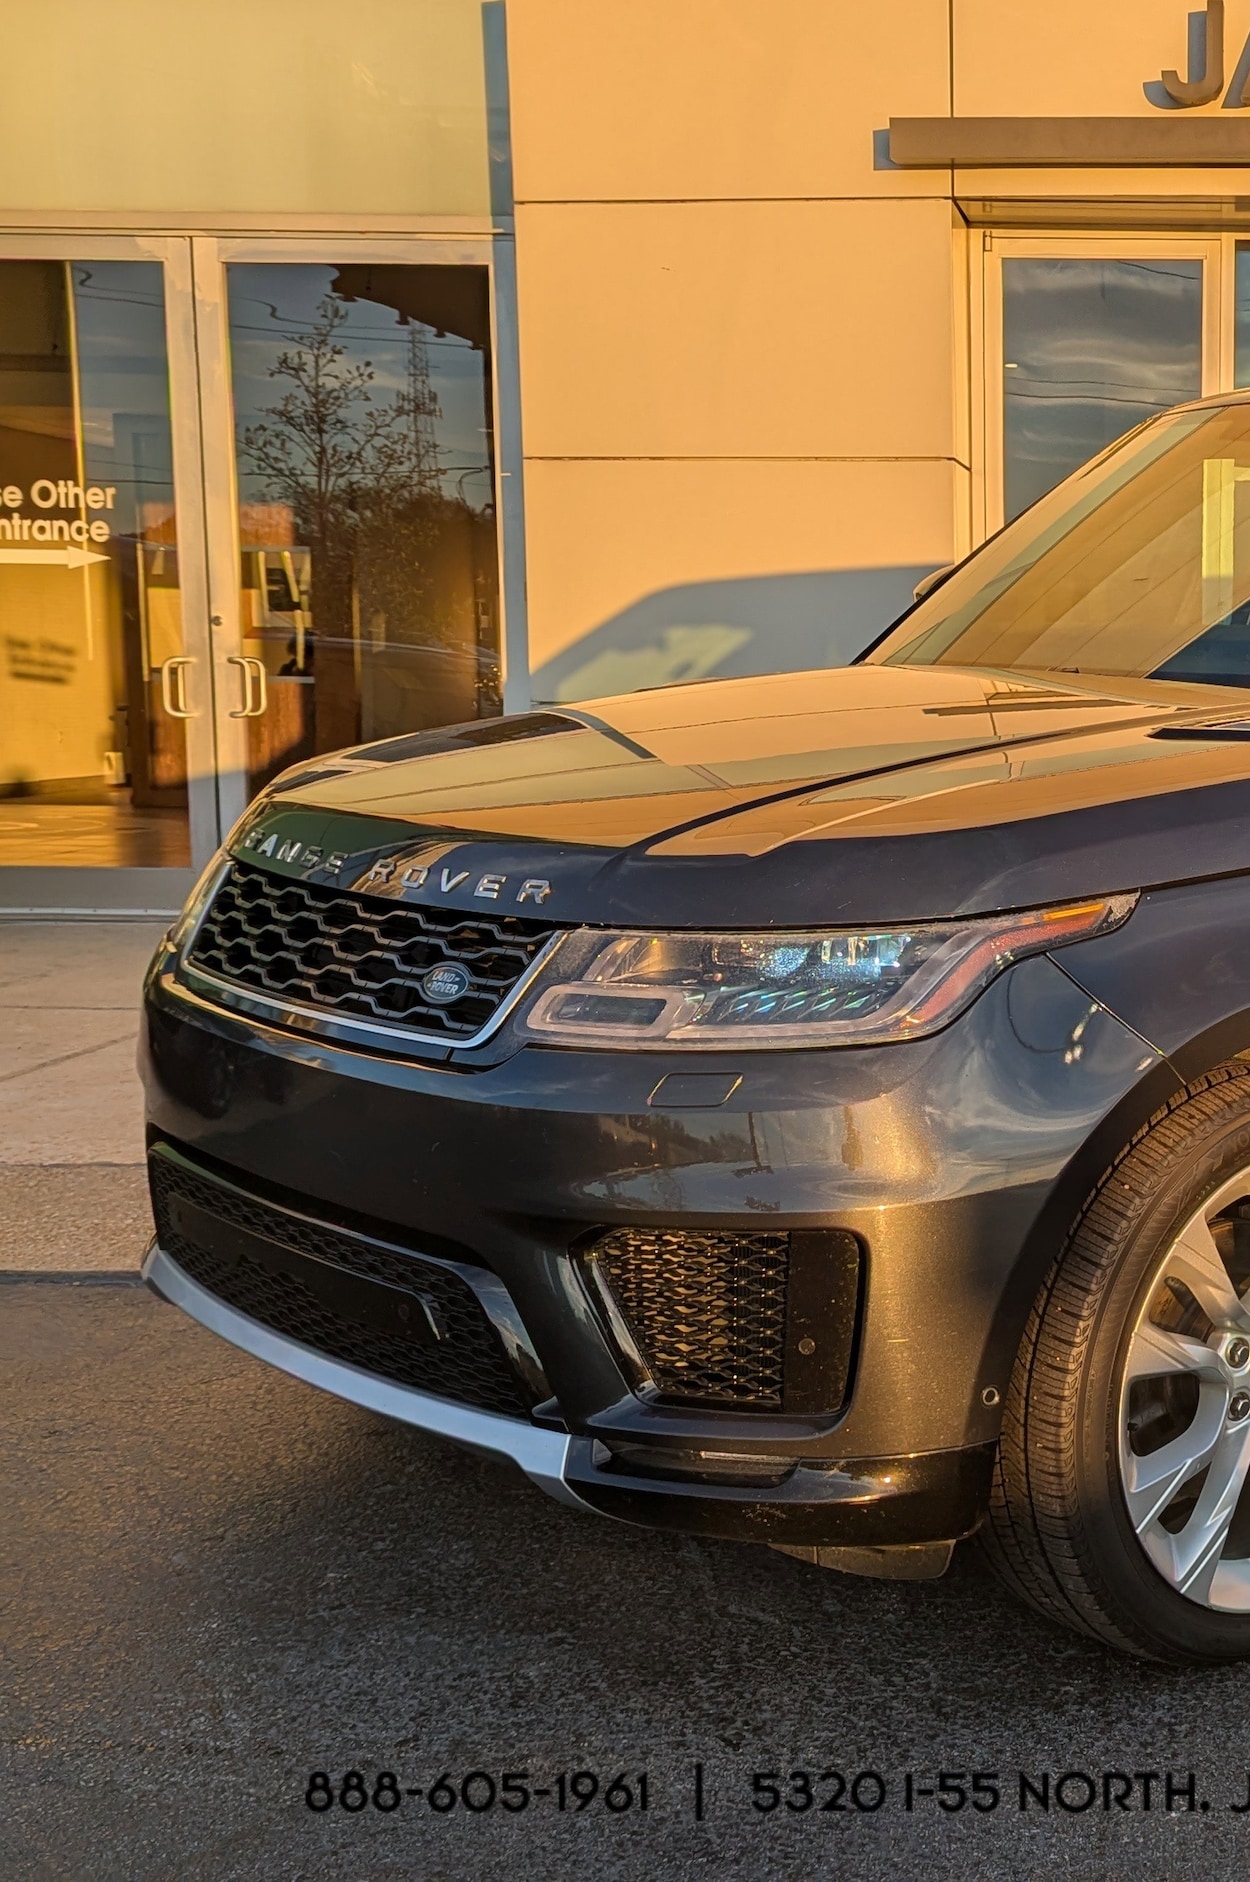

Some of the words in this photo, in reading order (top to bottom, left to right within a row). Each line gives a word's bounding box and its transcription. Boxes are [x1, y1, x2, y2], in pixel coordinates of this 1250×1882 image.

[30, 479, 117, 509] Other
[244, 827, 349, 876] RANGE
[367, 858, 552, 905] ROVER
[430, 980, 459, 995] ROVER
[432, 970, 456, 983] LAND
